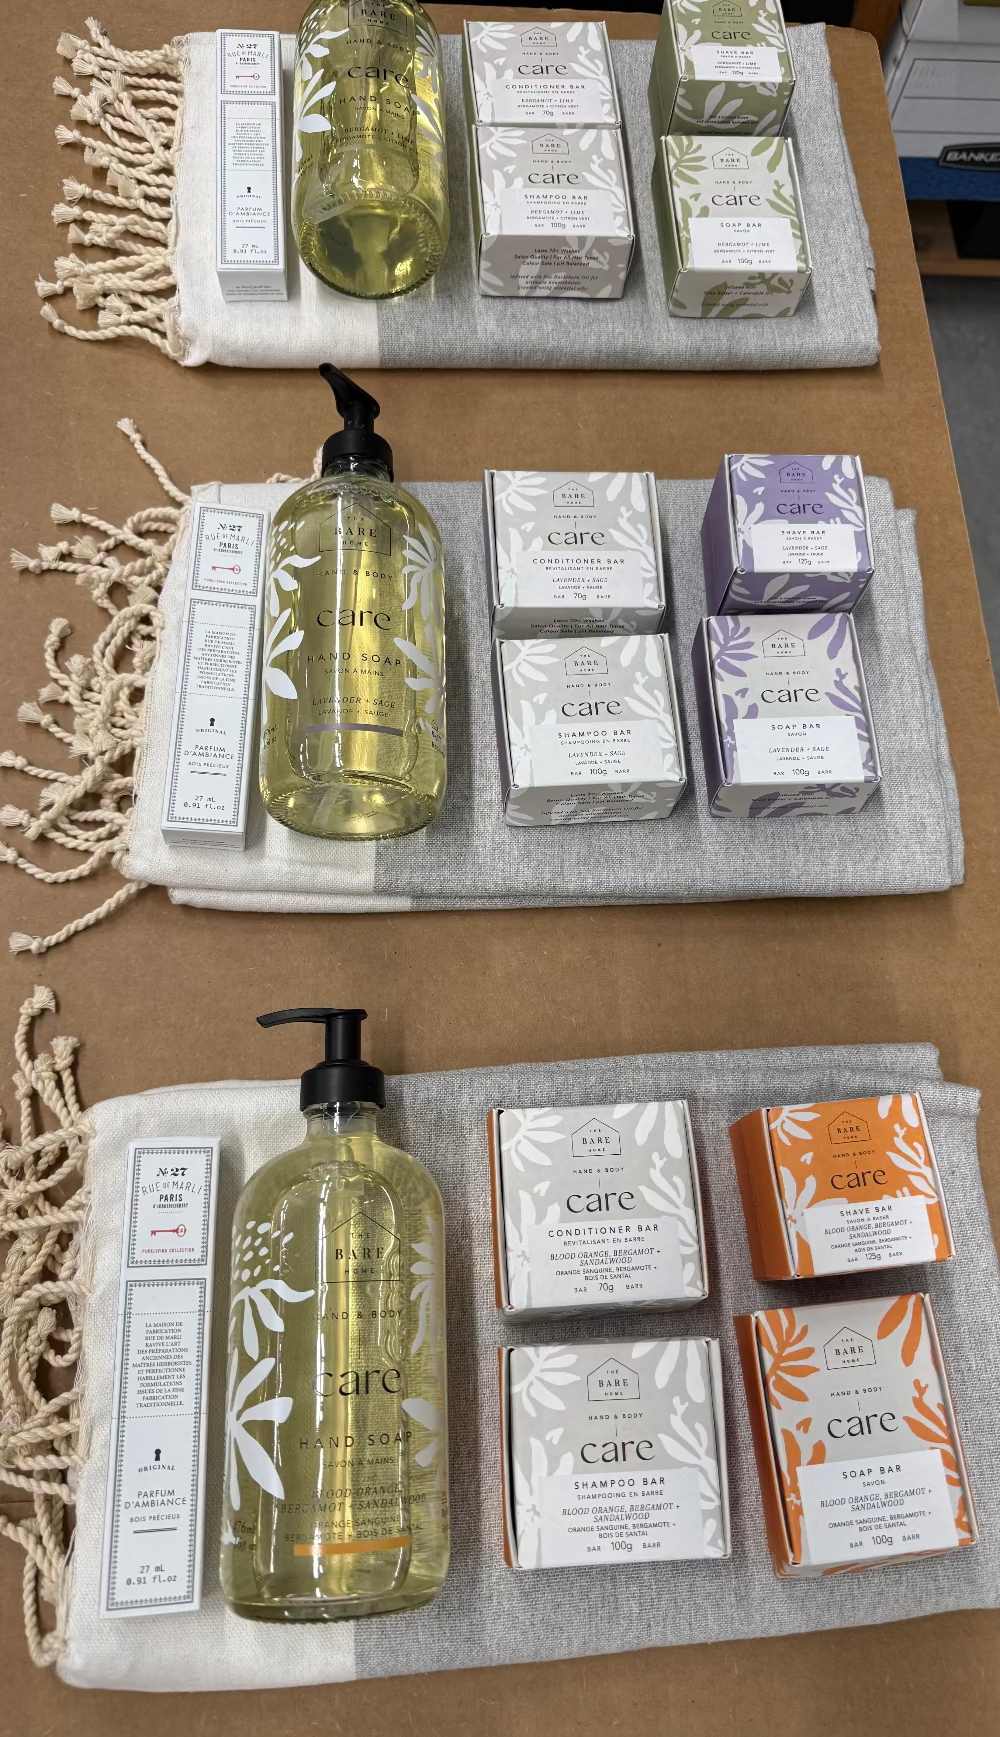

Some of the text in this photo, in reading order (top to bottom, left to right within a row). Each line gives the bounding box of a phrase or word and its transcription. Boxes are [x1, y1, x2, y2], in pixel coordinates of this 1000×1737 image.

[712, 30, 752, 40] care
[518, 62, 569, 75] care
[348, 64, 410, 89] care
[339, 96, 421, 116] HAND SOAP
[946, 151, 1000, 162] BANKE
[528, 173, 580, 185] care
[711, 193, 762, 206] care
[777, 503, 824, 515] care
[548, 531, 606, 546] care
[366, 571, 393, 580] BODY
[317, 608, 392, 630] care
[307, 653, 401, 666] HAND SOAP
[761, 688, 821, 703] care
[373, 699, 396, 708] SAGE
[562, 700, 622, 717] care
[184, 750, 235, 760] D'AMBIANCE
[590, 768, 607, 776] 100g
[582, 1137, 610, 1145] BARE
[170, 1167, 188, 1176] 27
[831, 1169, 888, 1189] care
[142, 1181, 160, 1195] RUE
[172, 1181, 202, 1195] MARLI
[159, 1194, 183, 1202] PARIS
[567, 1191, 636, 1214] care
[840, 1208, 871, 1216] SHAVE
[548, 1224, 659, 1237] CONDITIONER BAR
[335, 1248, 384, 1260] BARE
[577, 1250, 611, 1259] ORANGE,
[613, 1248, 654, 1256] BERGAMOT
[865, 1253, 881, 1261] 125g
[580, 1257, 632, 1266] SANDALWOOD
[599, 1283, 614, 1292] 70g
[835, 1346, 864, 1355] BARE
[312, 1368, 400, 1397] care
[599, 1379, 629, 1387] BARE
[827, 1411, 899, 1439] care
[300, 1432, 412, 1449] HAND SOAP
[581, 1439, 655, 1464] care
[842, 1465, 902, 1479] SOAP BAR
[574, 1477, 666, 1489] SHAMPOO BAR
[863, 1479, 885, 1487] SAVON
[138, 1490, 175, 1498] PARFUM
[577, 1492, 625, 1500] SHAMPOOING
[820, 1498, 846, 1507] BLOOD
[848, 1493, 882, 1504] ORANGE,
[884, 1488, 925, 1500] BERGAMOT
[125, 1497, 187, 1509] D'AMBIANCE
[562, 1507, 589, 1515] BLOOD
[592, 1505, 627, 1514] ORANGE,
[630, 1503, 673, 1512] BERGAMOT
[850, 1499, 904, 1512] SANDALWOOD
[594, 1512, 650, 1522] SANDALWOOD
[611, 1541, 633, 1551] 100g
[872, 1535, 893, 1545] 100g
[127, 1575, 177, 1585] 0.91 fl.oz
